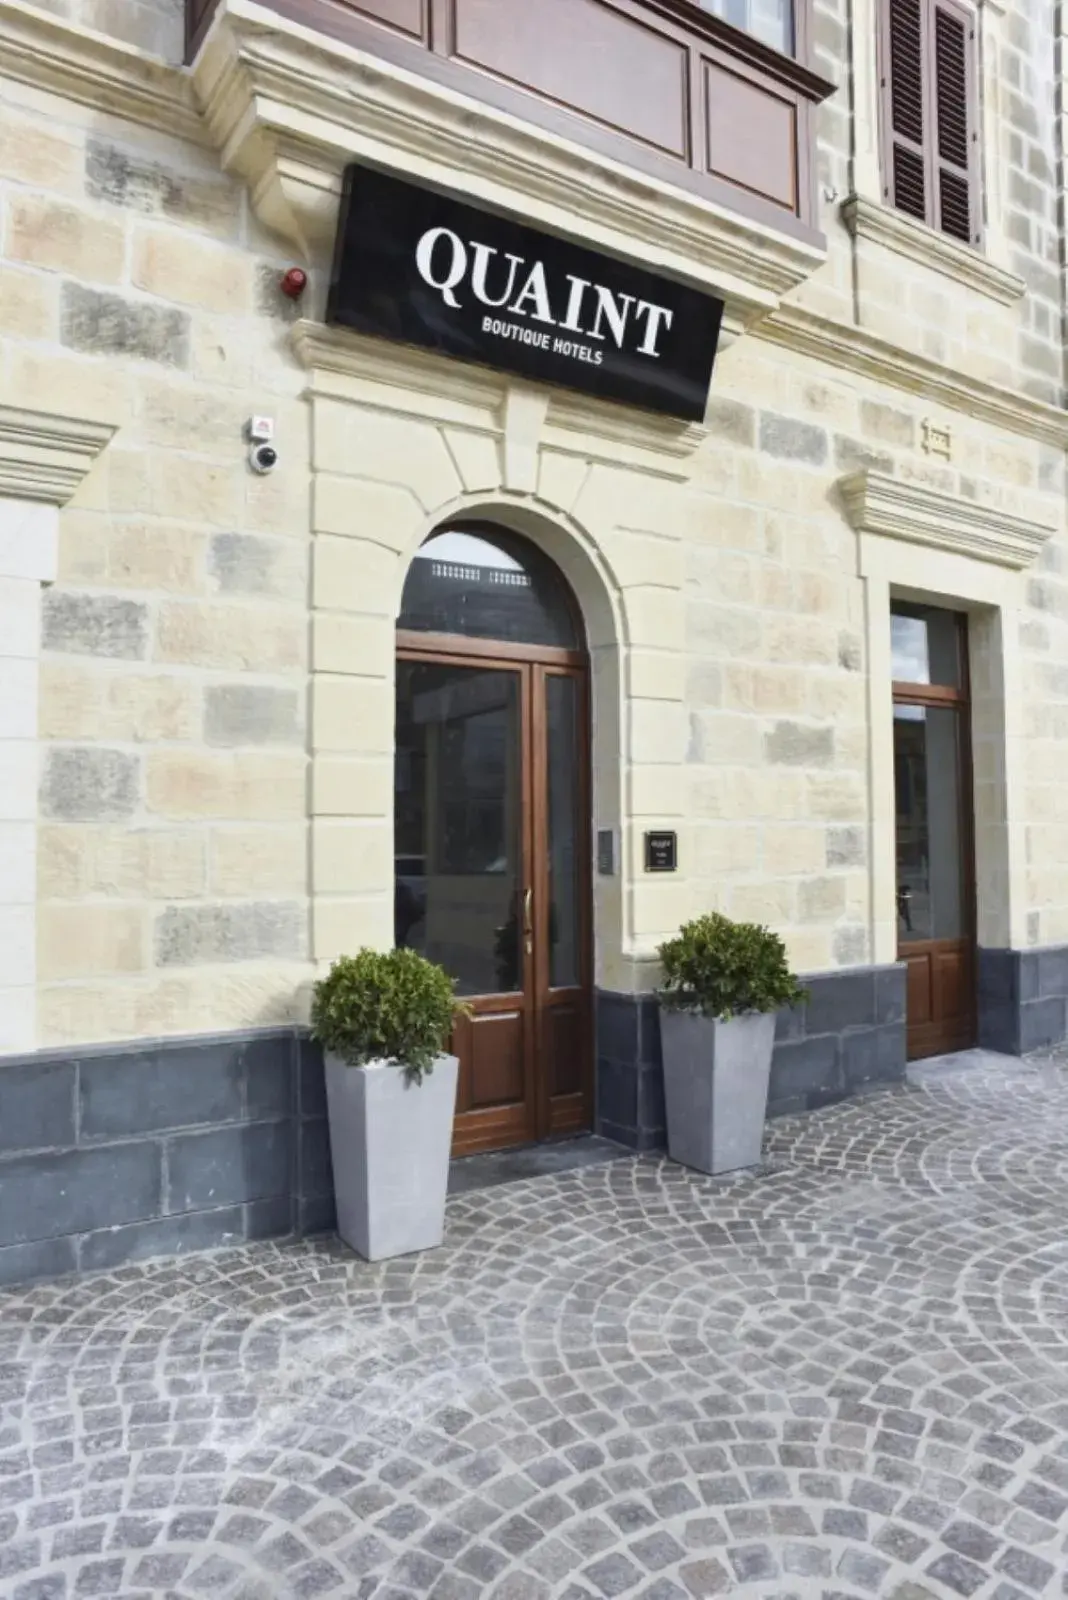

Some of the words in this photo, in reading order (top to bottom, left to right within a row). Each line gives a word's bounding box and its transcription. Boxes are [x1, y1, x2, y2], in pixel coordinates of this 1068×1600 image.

[415, 227, 673, 358] QUAINT
[482, 316, 549, 350] BOUTIQUE
[553, 338, 603, 366] HOTELS
